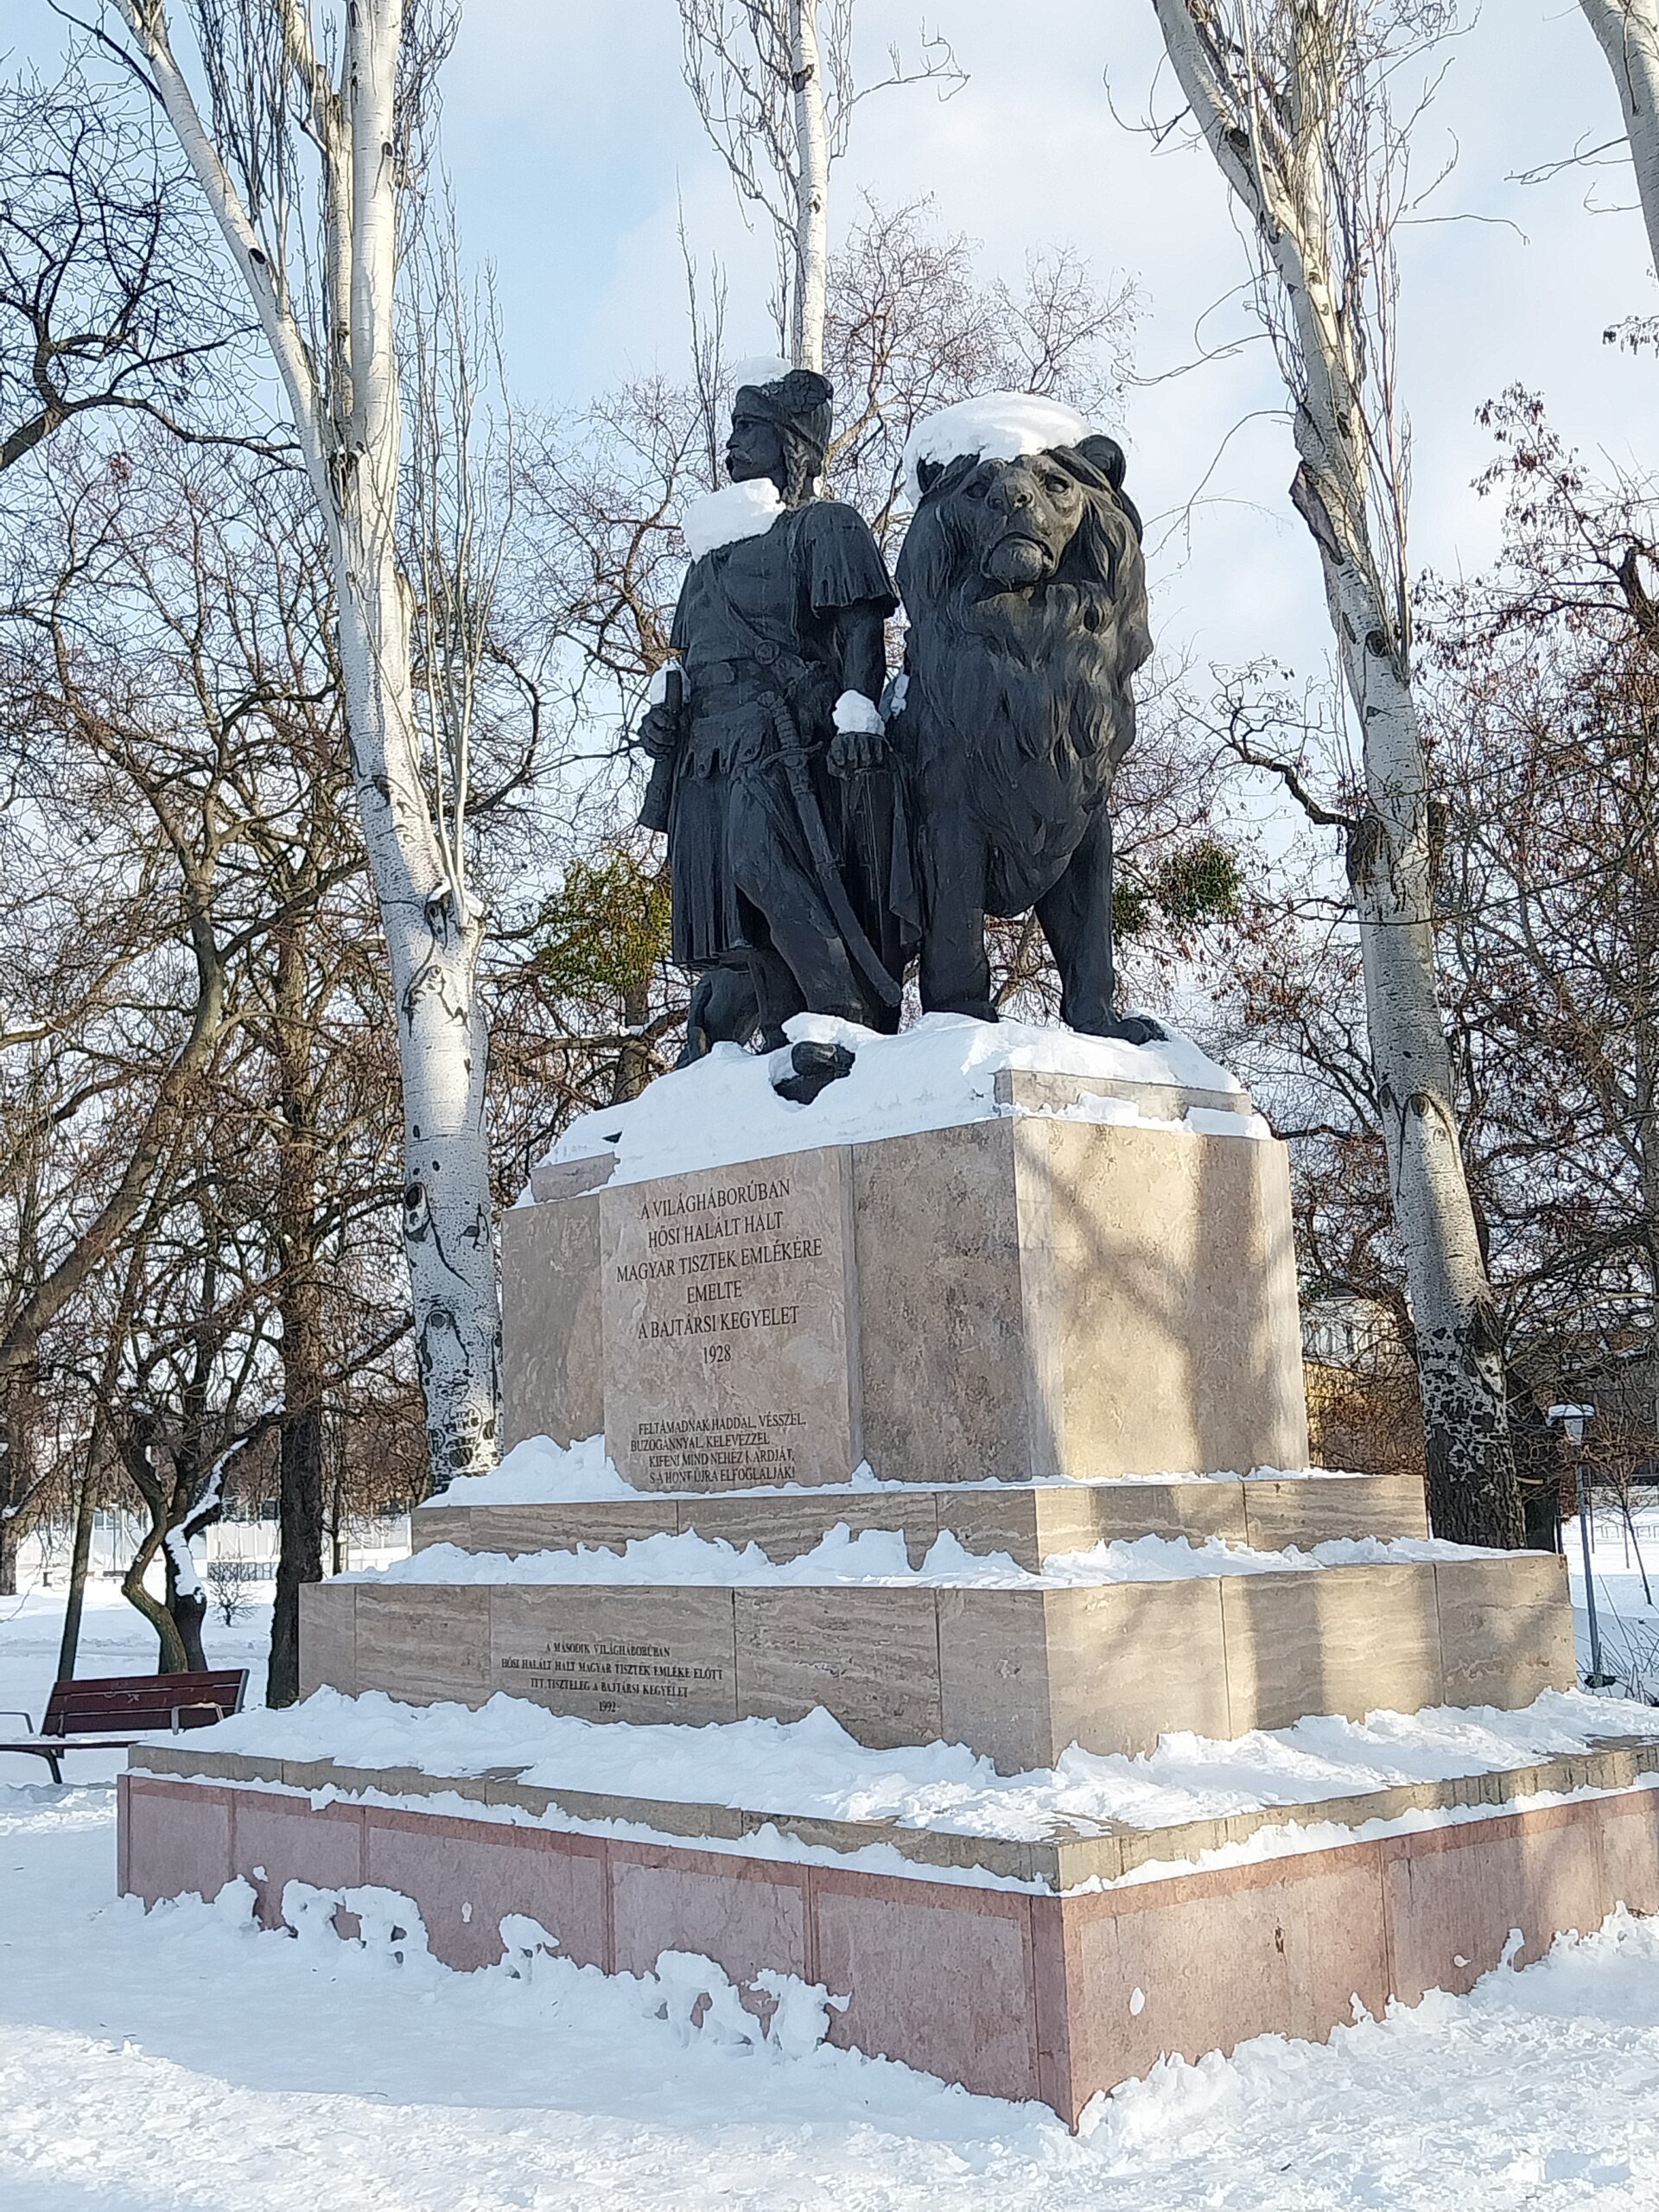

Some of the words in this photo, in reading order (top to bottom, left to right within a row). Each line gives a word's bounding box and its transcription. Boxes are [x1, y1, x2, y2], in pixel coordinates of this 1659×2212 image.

[640, 1203, 651, 1220] A
[652, 1178, 791, 1218] VILÁGHÁBORÚBAN
[648, 1225, 681, 1249] HŐSI
[683, 1216, 741, 1243] HALÁLT
[744, 1211, 784, 1234] HALT
[616, 1260, 676, 1283] MAGYAR
[679, 1249, 738, 1275] TISZTEK
[741, 1236, 823, 1266] EMLÉKÉRE
[687, 1280, 743, 1304] EMELTE
[638, 1325, 648, 1339] A
[651, 1313, 717, 1338] BAJTÁRSI
[721, 1305, 800, 1332] KEGYELET
[703, 1344, 731, 1363] 1928
[639, 1419, 709, 1435] FELTÁMADNAK
[545, 1643, 550, 1652] A
[555, 1660, 575, 1672] HALT
[578, 1661, 612, 1674] MAGYAR
[614, 1663, 651, 1676] TISZTEK
[547, 1679, 589, 1691] TISZTELEG
[593, 1681, 599, 1692] A
[643, 1684, 689, 1698] KEGYELET
[599, 1700, 616, 1713] 1992
